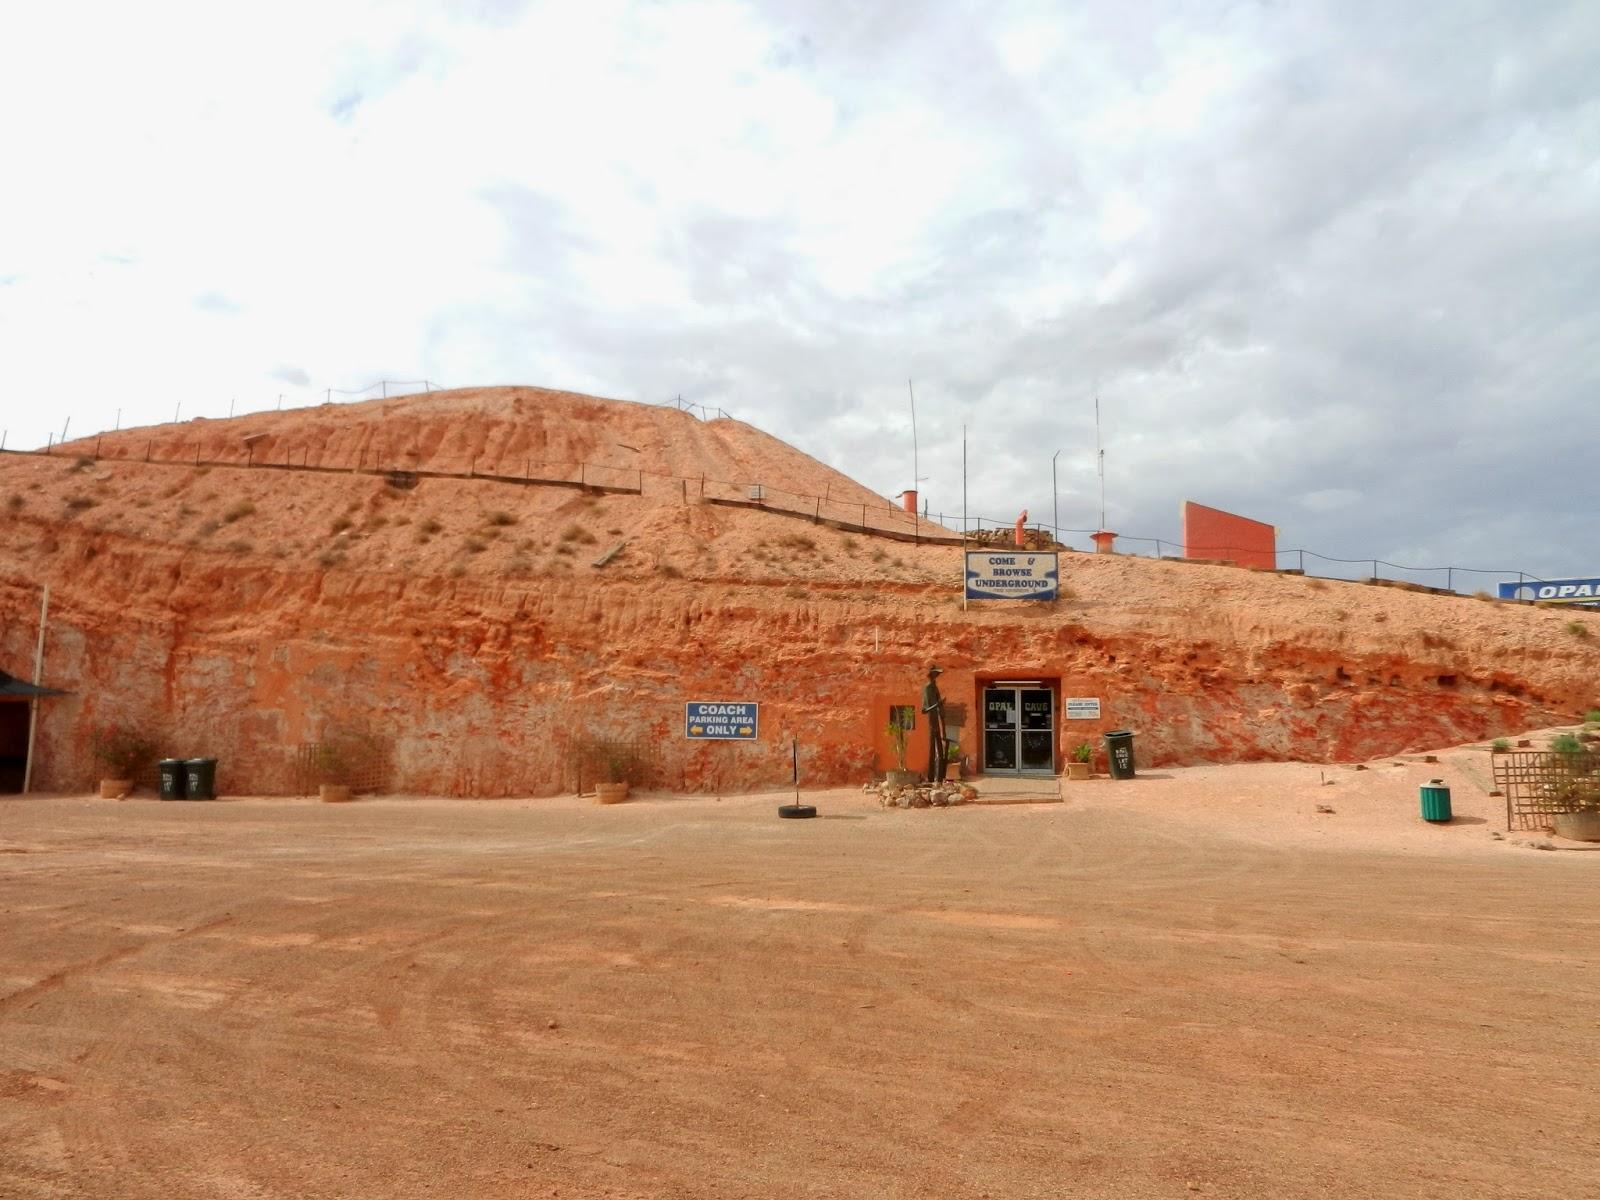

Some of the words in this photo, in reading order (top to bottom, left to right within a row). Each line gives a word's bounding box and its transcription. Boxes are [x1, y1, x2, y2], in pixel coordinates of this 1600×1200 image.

[988, 557, 1015, 566] COME
[992, 568, 1032, 577] BROWSE
[975, 579, 1049, 588] UNDERGROUND
[698, 704, 746, 715] COACH
[989, 702, 1013, 712] OPAL
[1024, 702, 1048, 712] CAVE
[688, 715, 729, 724] PARKING
[730, 716, 754, 724] AREA
[706, 725, 737, 735] ONLY
